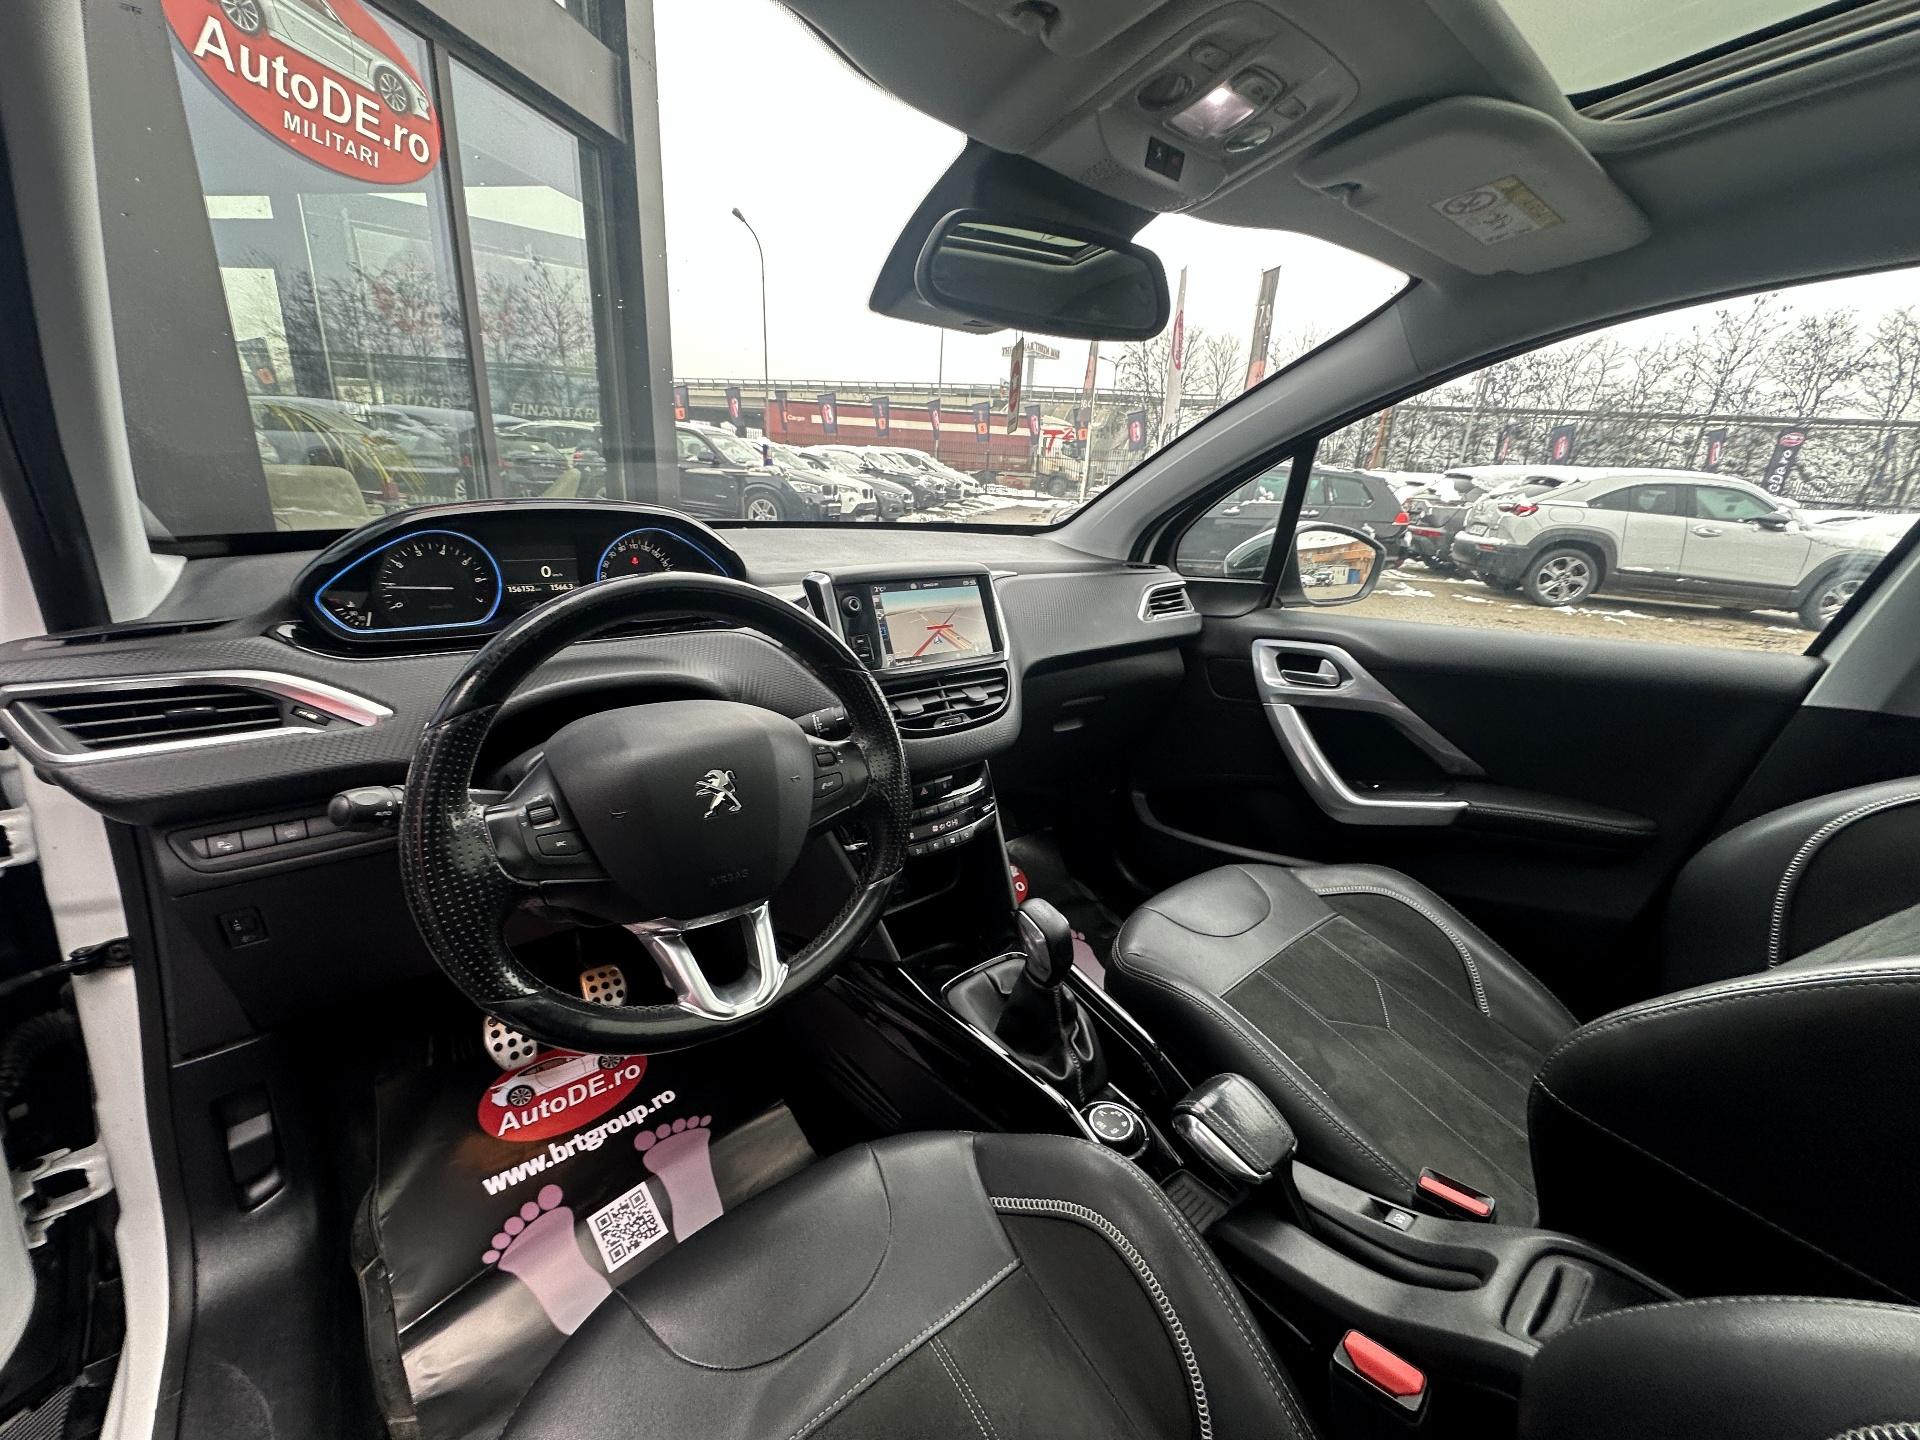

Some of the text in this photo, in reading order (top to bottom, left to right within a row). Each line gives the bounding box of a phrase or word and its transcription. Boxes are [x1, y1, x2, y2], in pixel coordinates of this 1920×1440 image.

[193, 14, 430, 164] AutoDE.ro
[283, 109, 380, 169] MILITARI
[507, 585, 536, 593] 156152
[540, 565, 552, 578] 0
[497, 1062, 642, 1137] AutoDE.ro
[482, 1089, 676, 1196] www.brtgroup.ro
